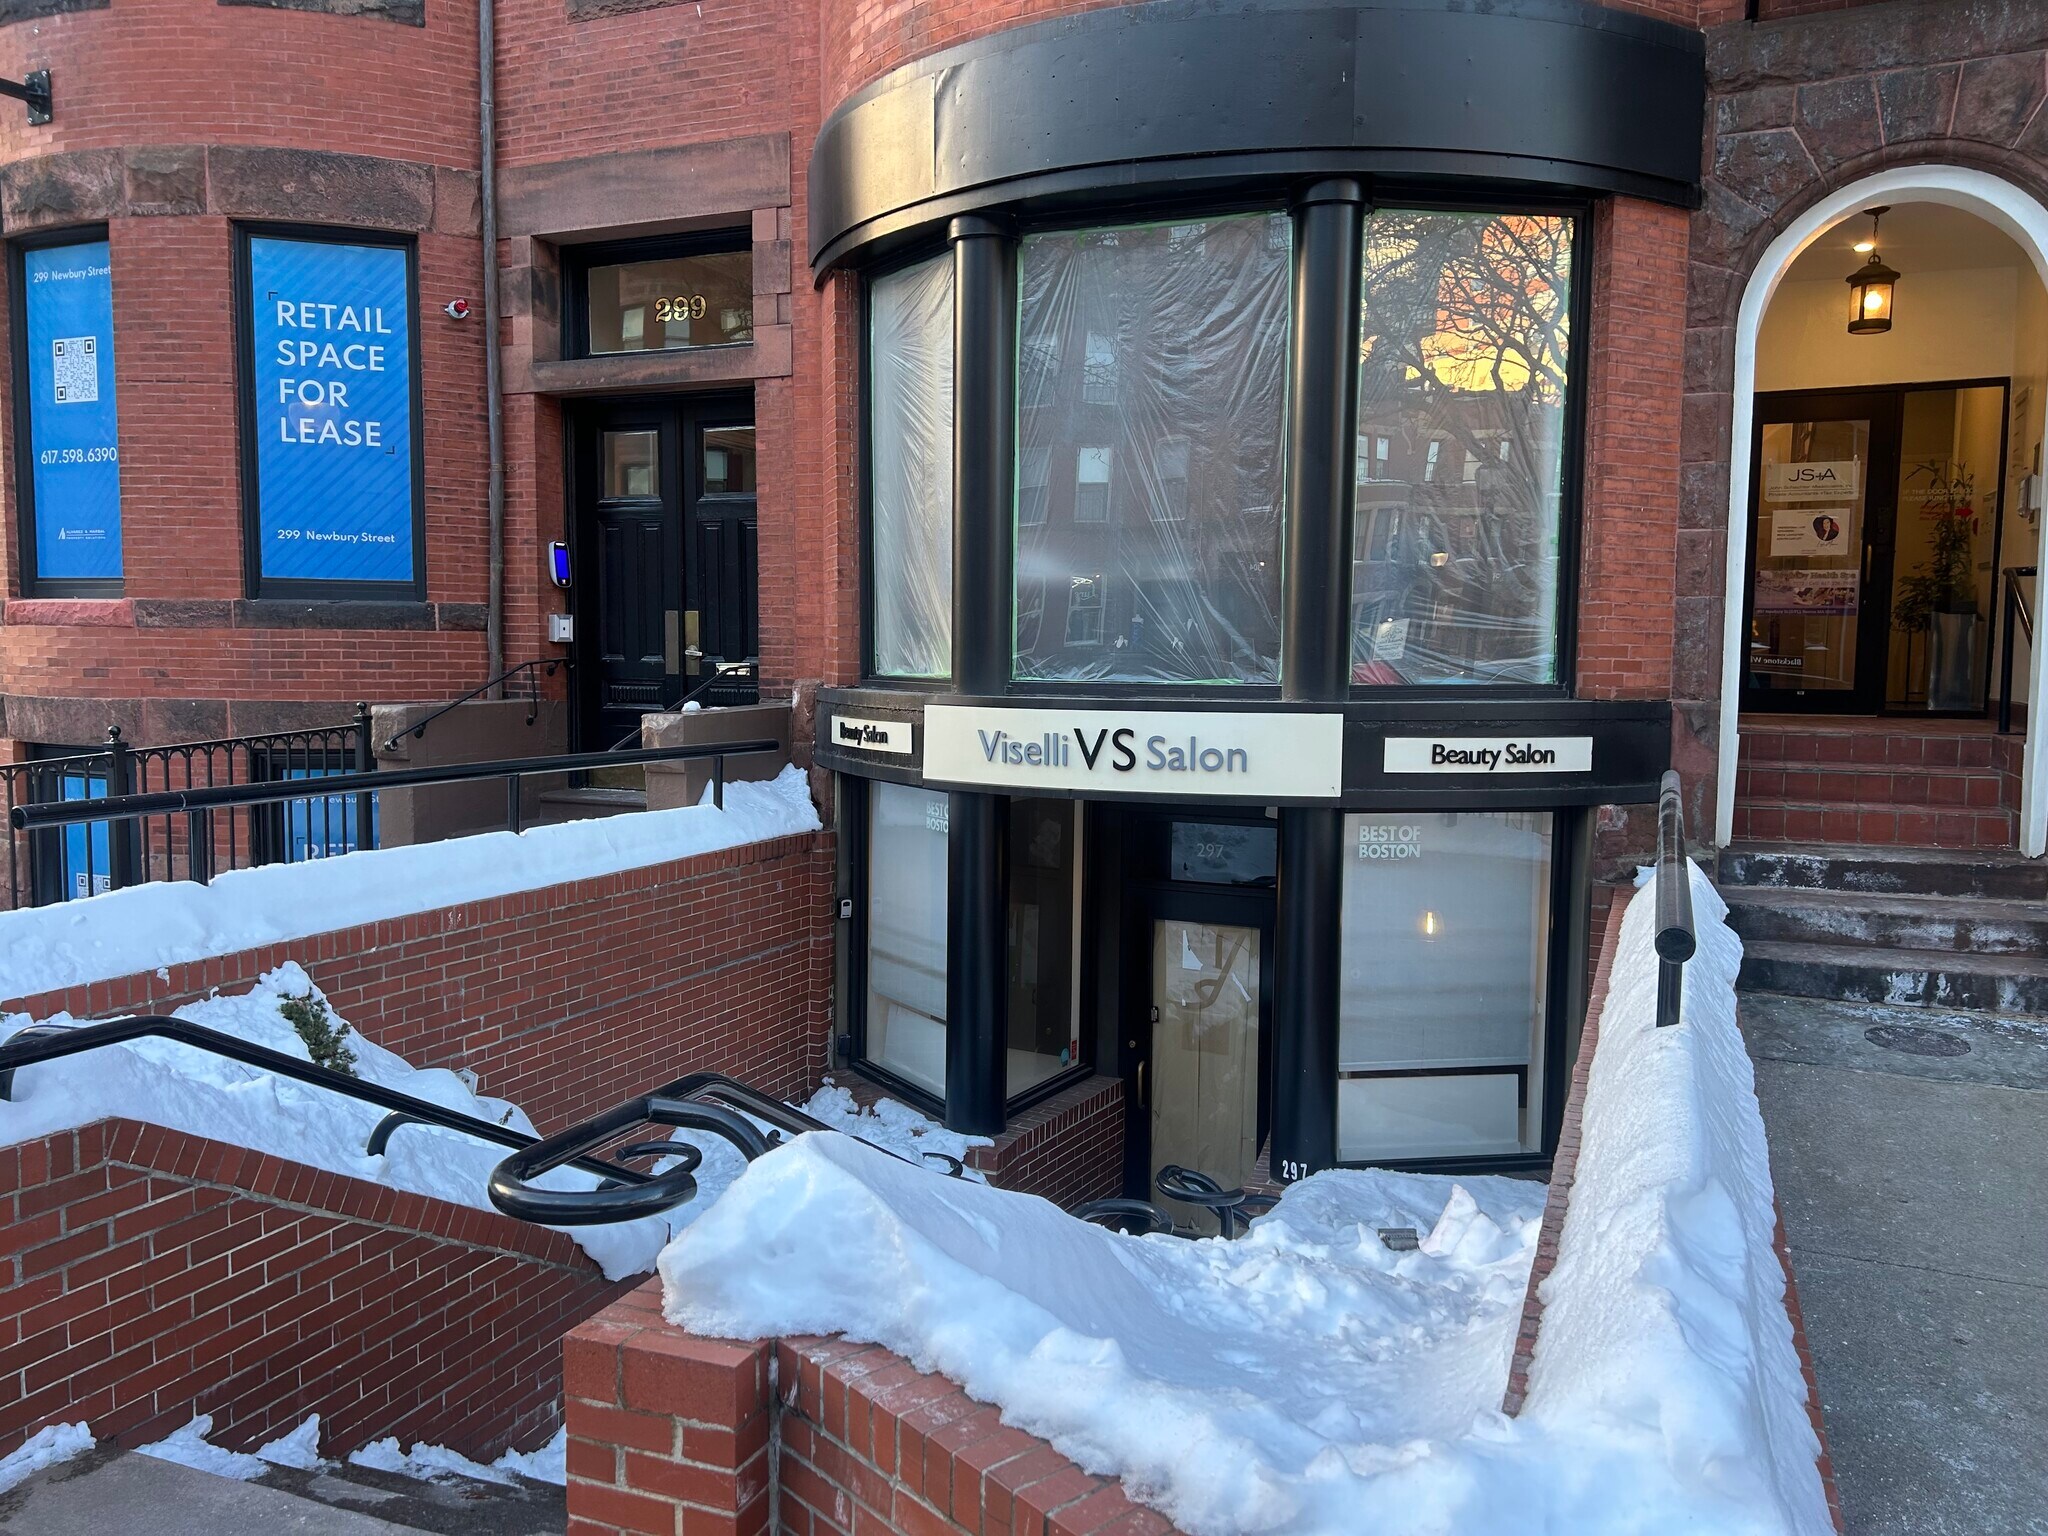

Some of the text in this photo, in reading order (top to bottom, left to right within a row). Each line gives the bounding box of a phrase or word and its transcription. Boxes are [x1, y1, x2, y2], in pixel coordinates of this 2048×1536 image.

[33, 264, 112, 283] 299 Newbury Street
[276, 300, 392, 334] RETAIL
[654, 294, 707, 323] 299
[276, 339, 385, 372] SPACE
[279, 378, 350, 408] FOR
[280, 416, 382, 447] LEASE
[40, 447, 118, 465] 617.598.6390
[277, 529, 395, 544] 299 Newbury Street
[840, 722, 888, 746] Beauty Salon
[978, 728, 1248, 773] Viselli VS Salon
[1431, 743, 1556, 771] Beauty Salon
[926, 801, 944, 817] BEST
[926, 816, 949, 833] BOSTO
[1359, 825, 1422, 841] BEST OF
[1196, 843, 1225, 858] 297
[1358, 843, 1422, 859] BOSTON
[1282, 1159, 1308, 1181] 297
